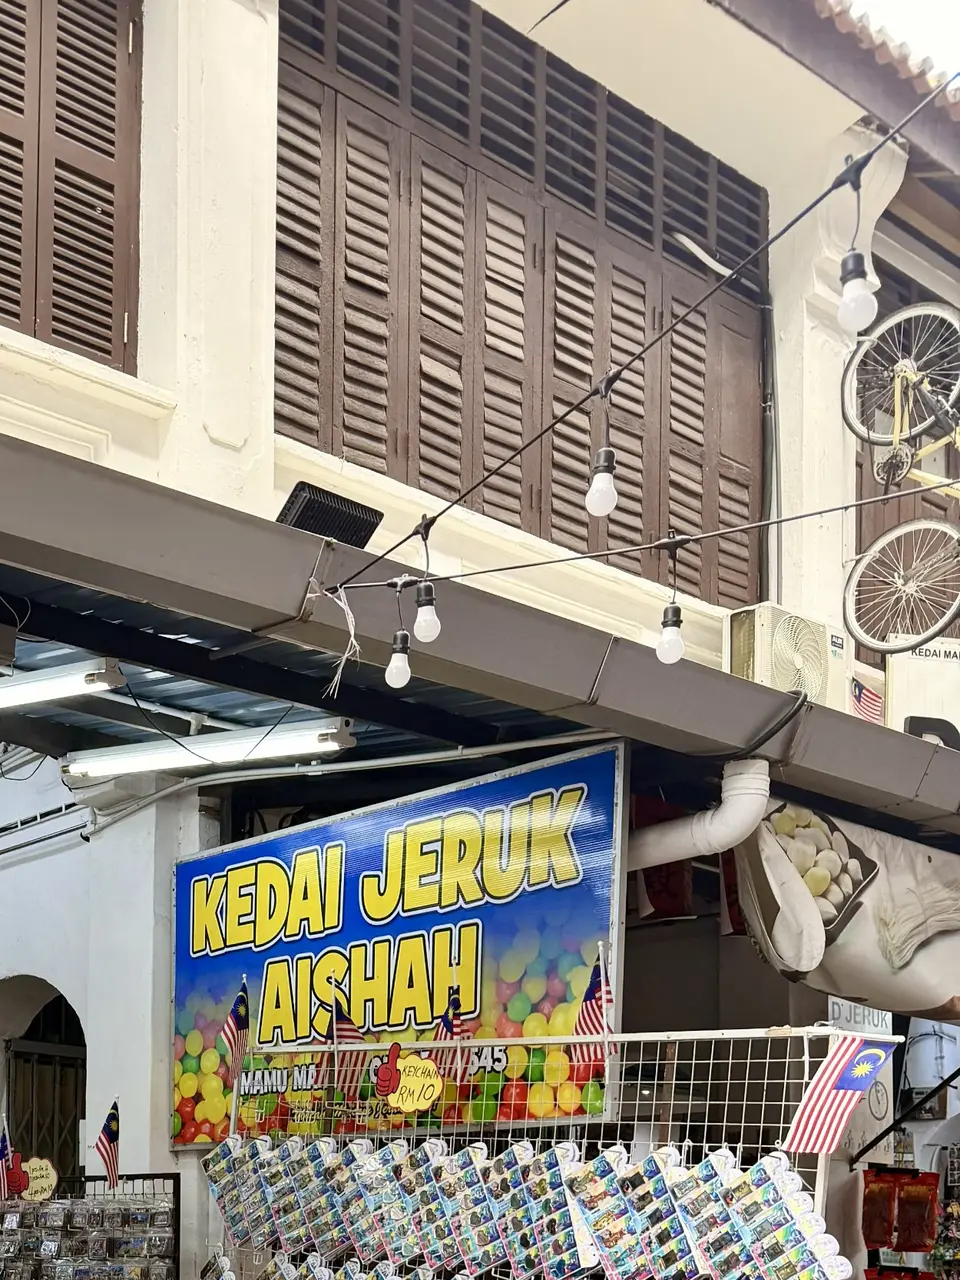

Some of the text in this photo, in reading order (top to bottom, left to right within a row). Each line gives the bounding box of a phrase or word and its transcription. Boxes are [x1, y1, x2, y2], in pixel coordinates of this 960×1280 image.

[911, 648, 941, 659] KEDAI
[189, 783, 588, 957] KEDAI JERUK
[256, 920, 483, 1047] AISHAH
[240, 1067, 288, 1096] MAMU
[401, 1065, 439, 1080] KEYCHAIN
